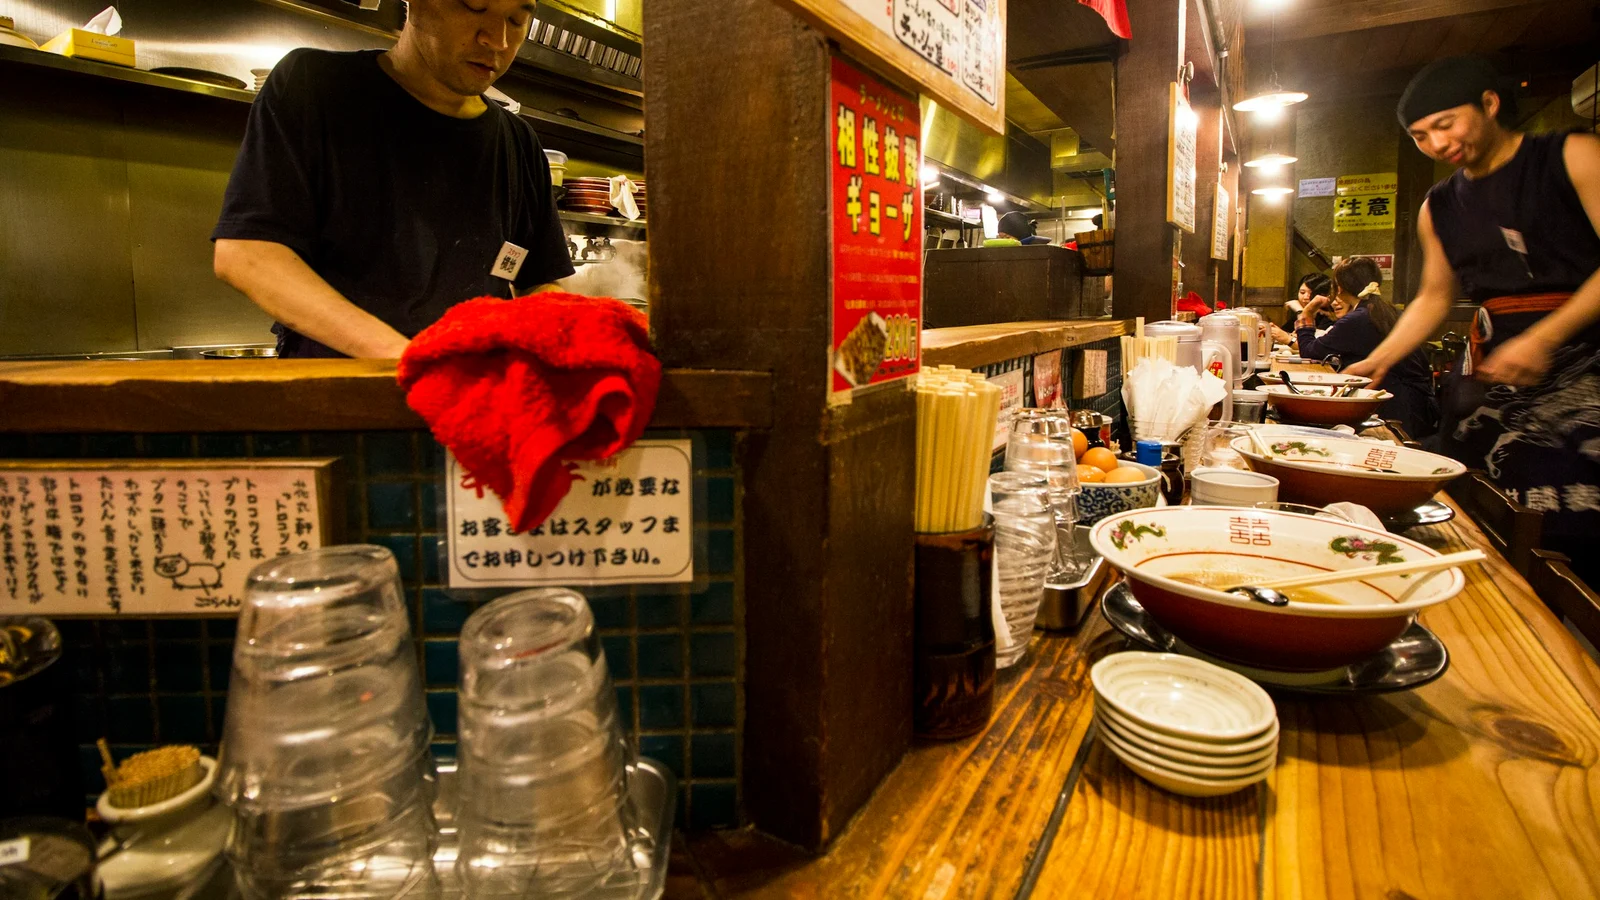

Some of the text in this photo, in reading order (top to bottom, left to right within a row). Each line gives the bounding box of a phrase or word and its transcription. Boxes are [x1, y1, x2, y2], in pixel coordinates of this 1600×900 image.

[836, 102, 919, 189] 相性抜群
[845, 173, 914, 242] ギョーザ
[1339, 197, 1389, 216] 注意
[591, 476, 681, 497] が必要な
[462, 547, 662, 568] でお申しつけ下さい。
